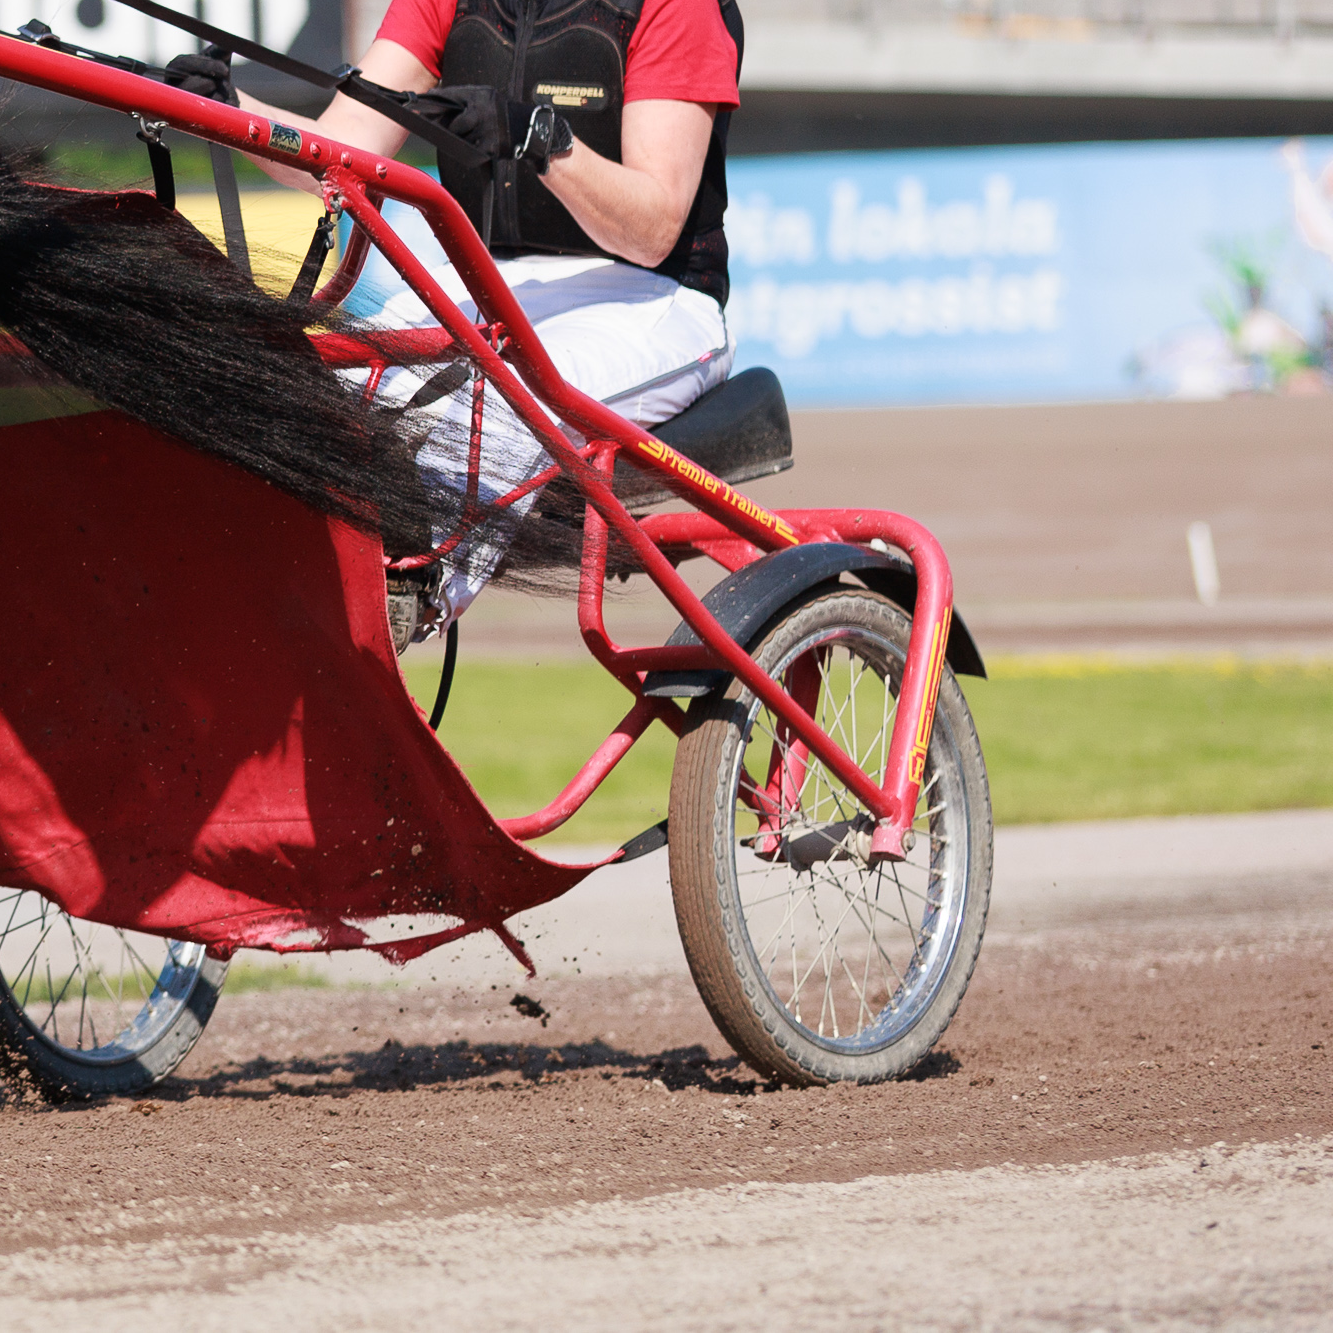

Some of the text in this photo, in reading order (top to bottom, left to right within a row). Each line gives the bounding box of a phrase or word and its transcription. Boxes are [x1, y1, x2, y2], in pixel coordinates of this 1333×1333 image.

[536, 84, 605, 98] KOMPERDELL
[661, 445, 776, 529] Premier Trainer
